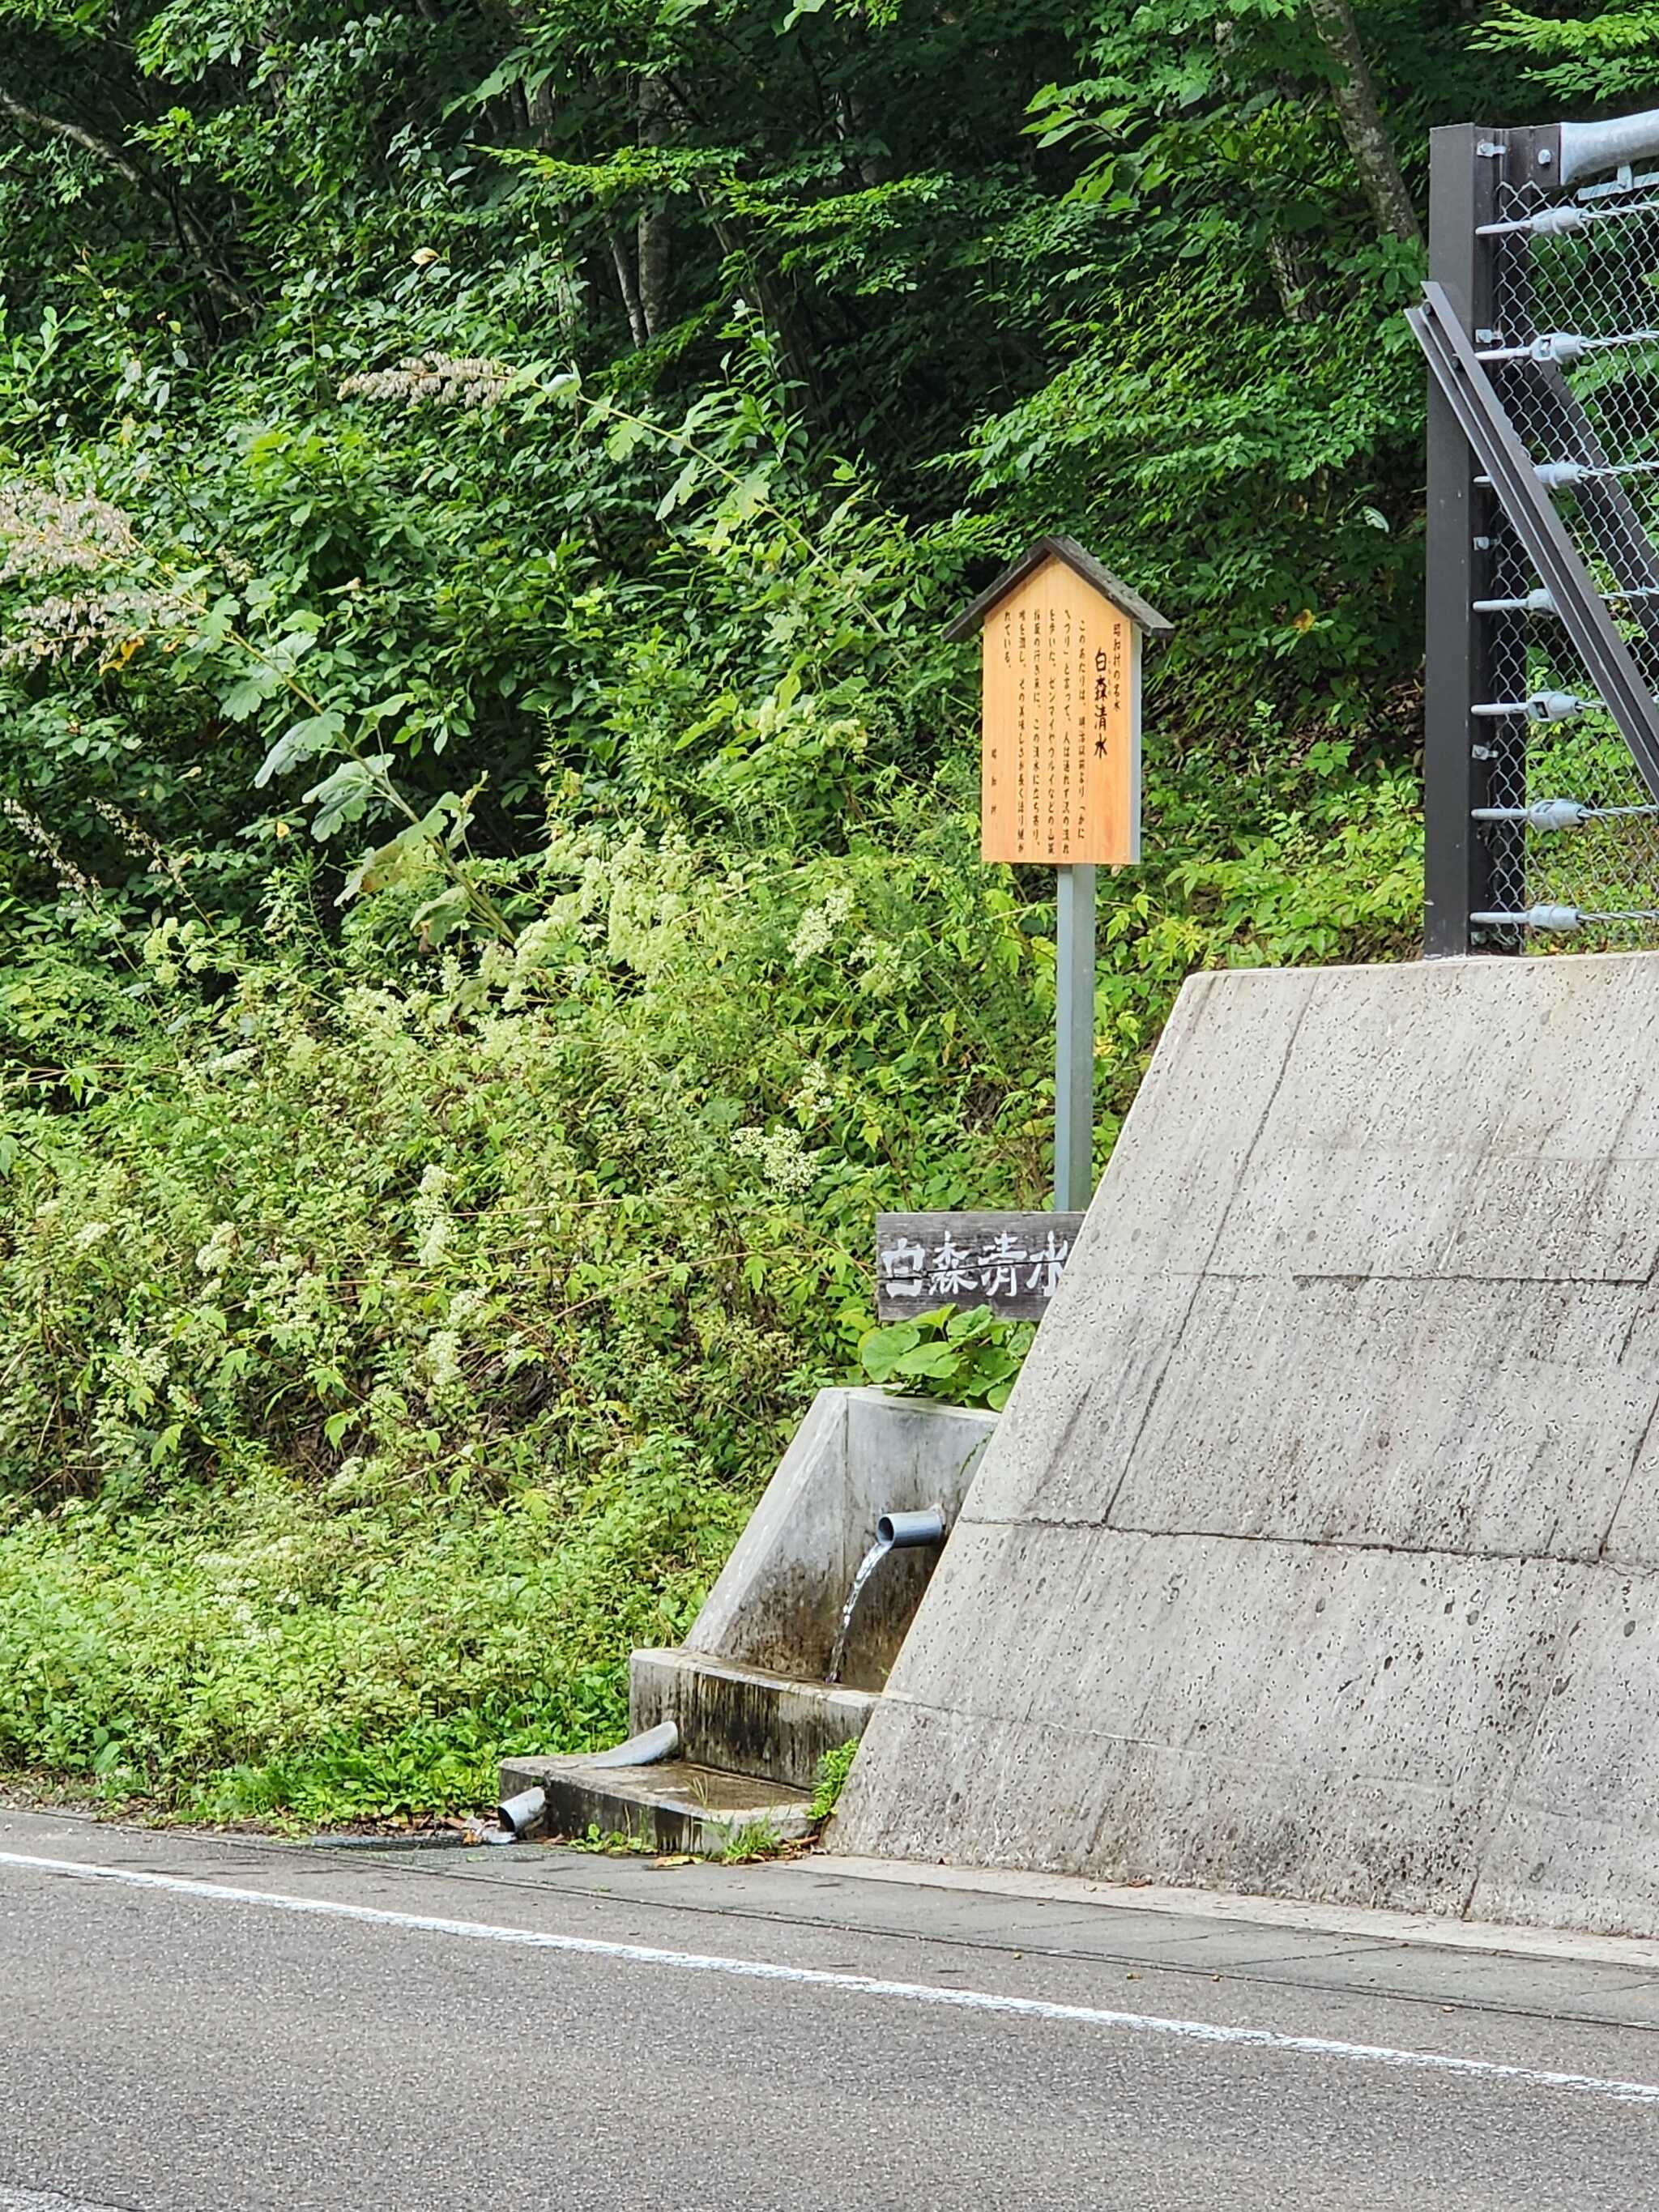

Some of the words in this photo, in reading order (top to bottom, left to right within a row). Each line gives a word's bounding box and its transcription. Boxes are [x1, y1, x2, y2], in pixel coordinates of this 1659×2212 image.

[1094, 646, 1107, 759] 白森清水
[881, 1230, 1068, 1298] 白森清水
